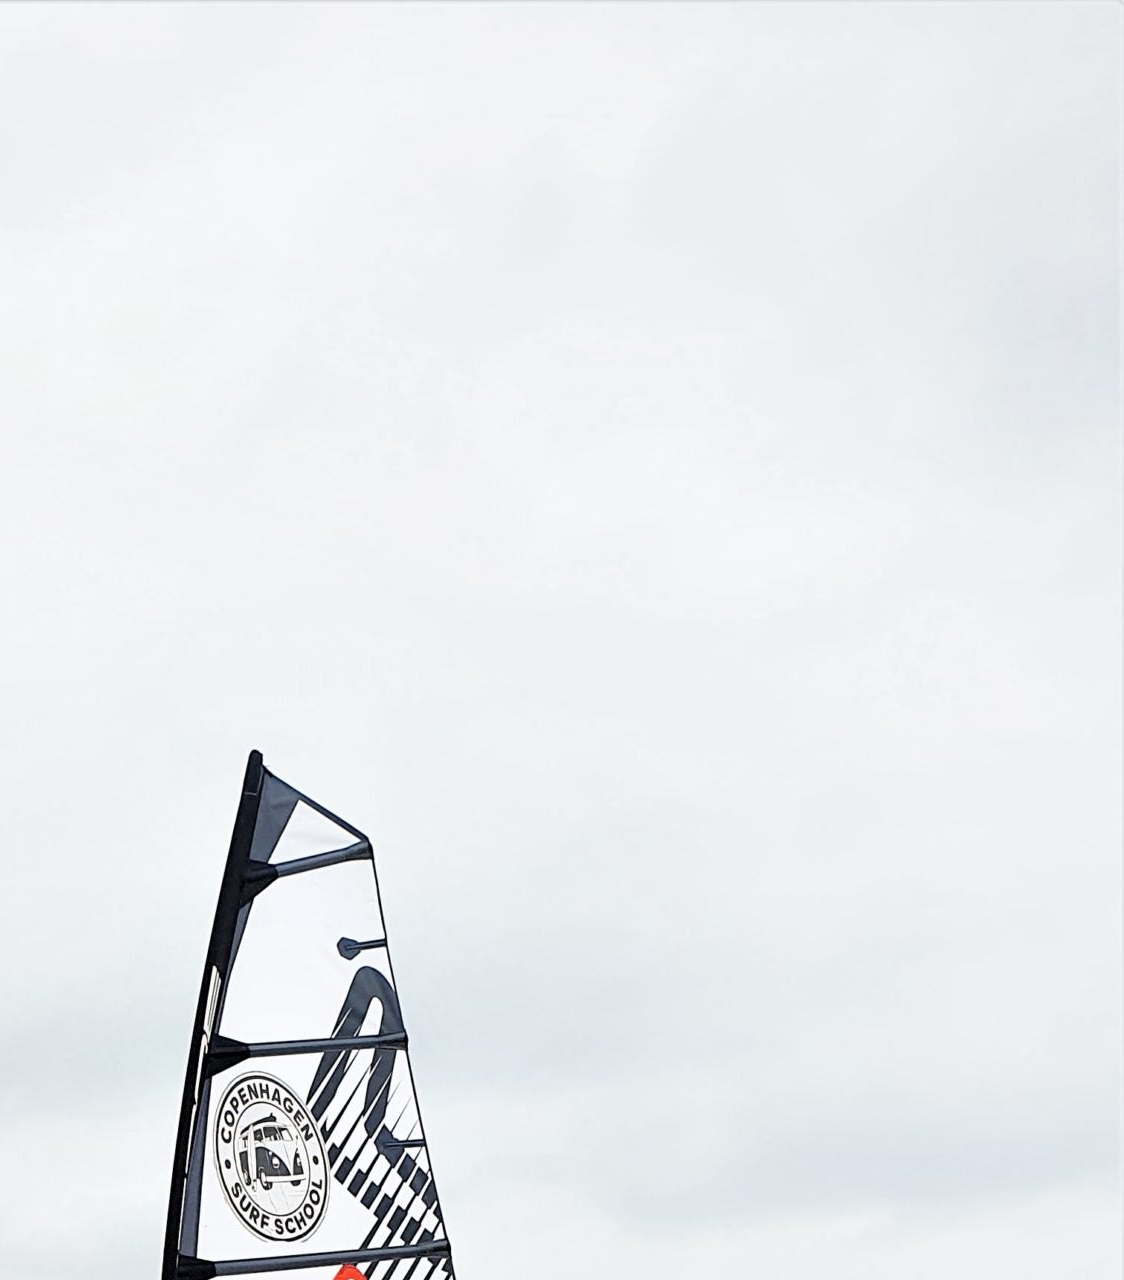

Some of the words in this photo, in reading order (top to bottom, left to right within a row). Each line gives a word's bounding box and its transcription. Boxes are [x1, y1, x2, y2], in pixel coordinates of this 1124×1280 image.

[220, 1082, 314, 1144] COPENHAGEN
[231, 1181, 271, 1230] SURF
[274, 1178, 323, 1236] SCHOOL
